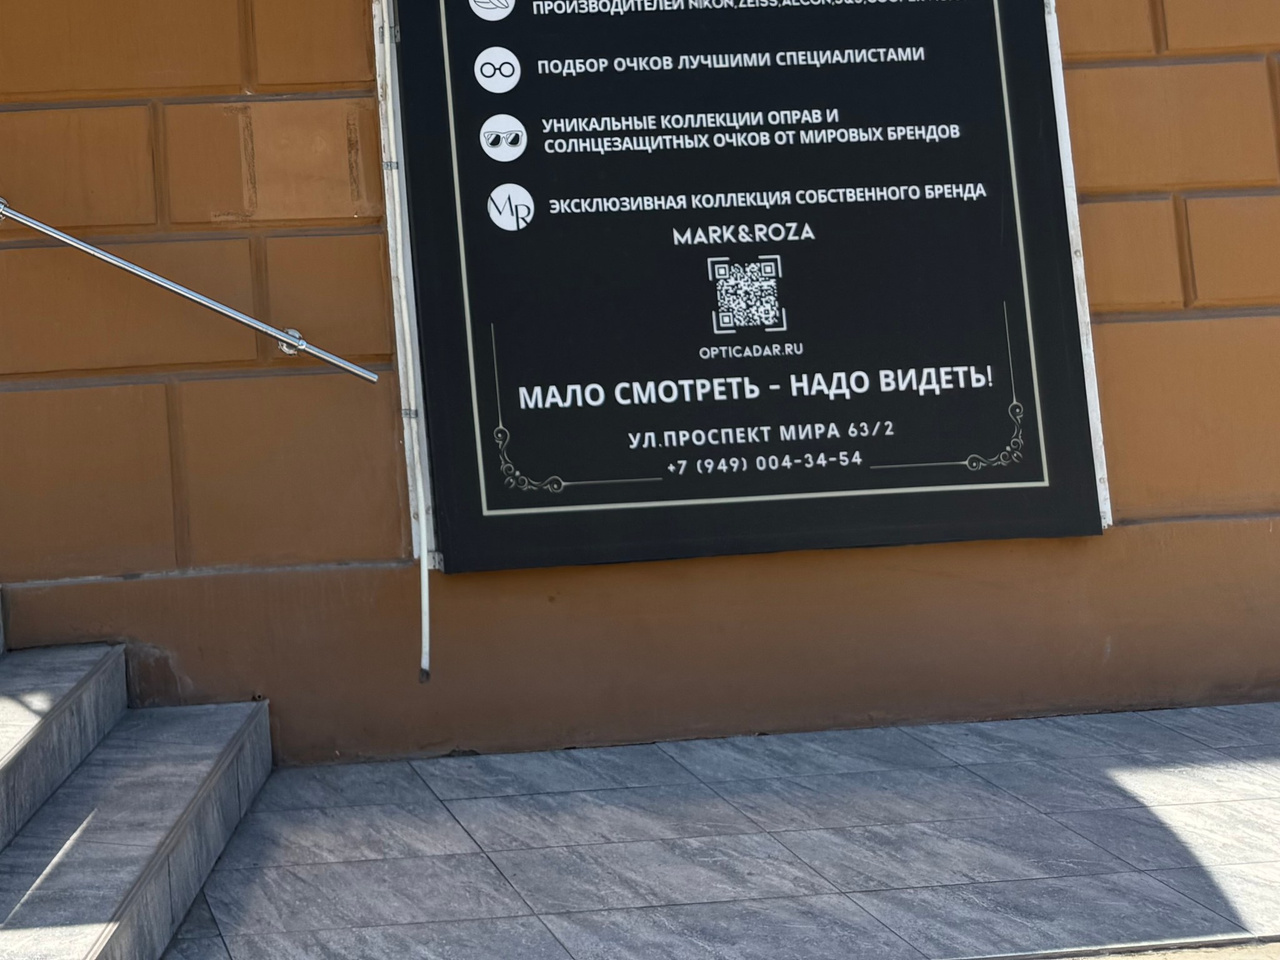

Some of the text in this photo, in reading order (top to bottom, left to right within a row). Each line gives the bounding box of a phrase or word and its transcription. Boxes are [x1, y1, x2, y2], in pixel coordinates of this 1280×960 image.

[537, 47, 925, 76] ПОДБОР ОЧКОВ ЛУЧШИМИ СПЕЦИАЛИСТАМИ
[542, 108, 839, 134] УНИКАЛЬНЫЕ КОЛЛЕКЦИИ ОПРАВ И
[544, 124, 960, 154] СОЛНЦЕЗАЩИТНЫХ ОЧКОВ ОТ МИРОВЫХ БРЕНДОВ
[549, 183, 987, 215] ЭКСКЛЮЗИВНАЯ КОЛЛЕКЦИЯ СОБСТВЕННОГО БРЕНДА
[673, 222, 816, 246] MARK&ROZA
[699, 343, 804, 360] OPTICADAR.RU
[518, 383, 606, 409] МАЛО
[614, 377, 760, 406] СМОТРЕТЬ
[790, 370, 870, 401] НАДО
[879, 365, 993, 397] ВИДЕТЬ!
[779, 422, 841, 442] МИРА
[848, 420, 895, 438] 63/2
[667, 450, 863, 476] +7 (949) 004-34-54
